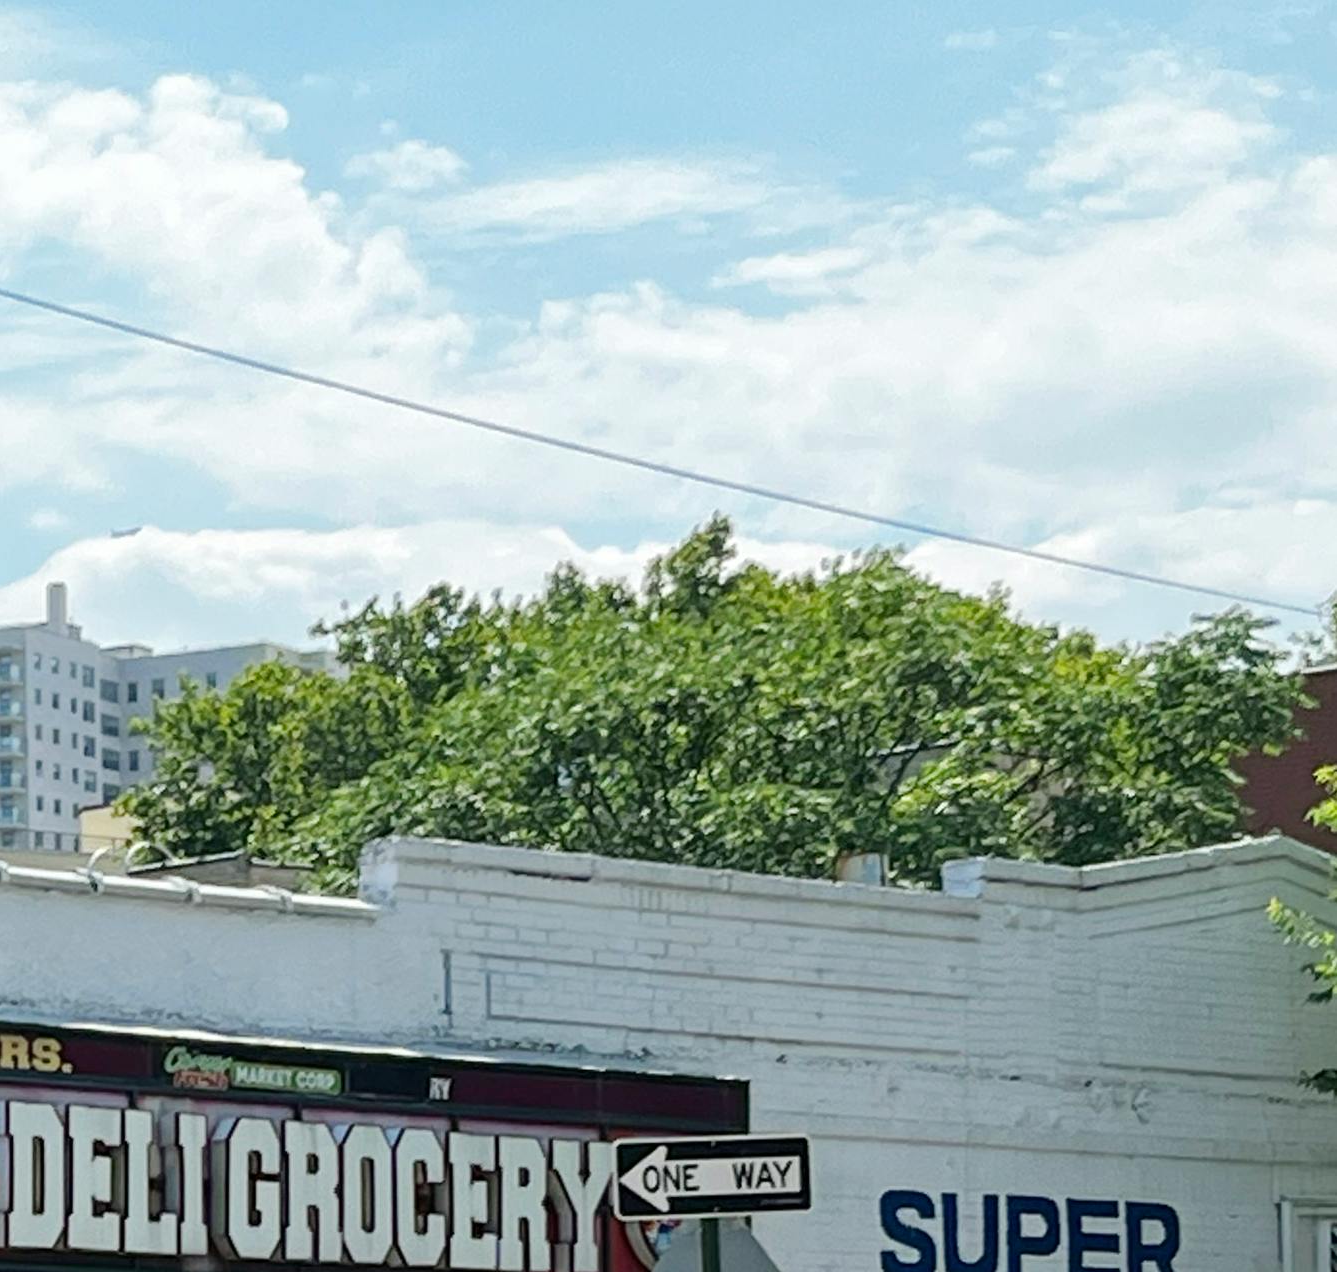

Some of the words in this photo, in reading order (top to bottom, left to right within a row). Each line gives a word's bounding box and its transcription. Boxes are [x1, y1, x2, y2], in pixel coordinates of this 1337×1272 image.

[163, 1046, 233, 1073] Corner
[235, 1064, 293, 1088] MARKET
[295, 1068, 336, 1090] CORP
[5, 1100, 208, 1257] DELI
[641, 1163, 701, 1193] ONE
[732, 1155, 794, 1190] WAY
